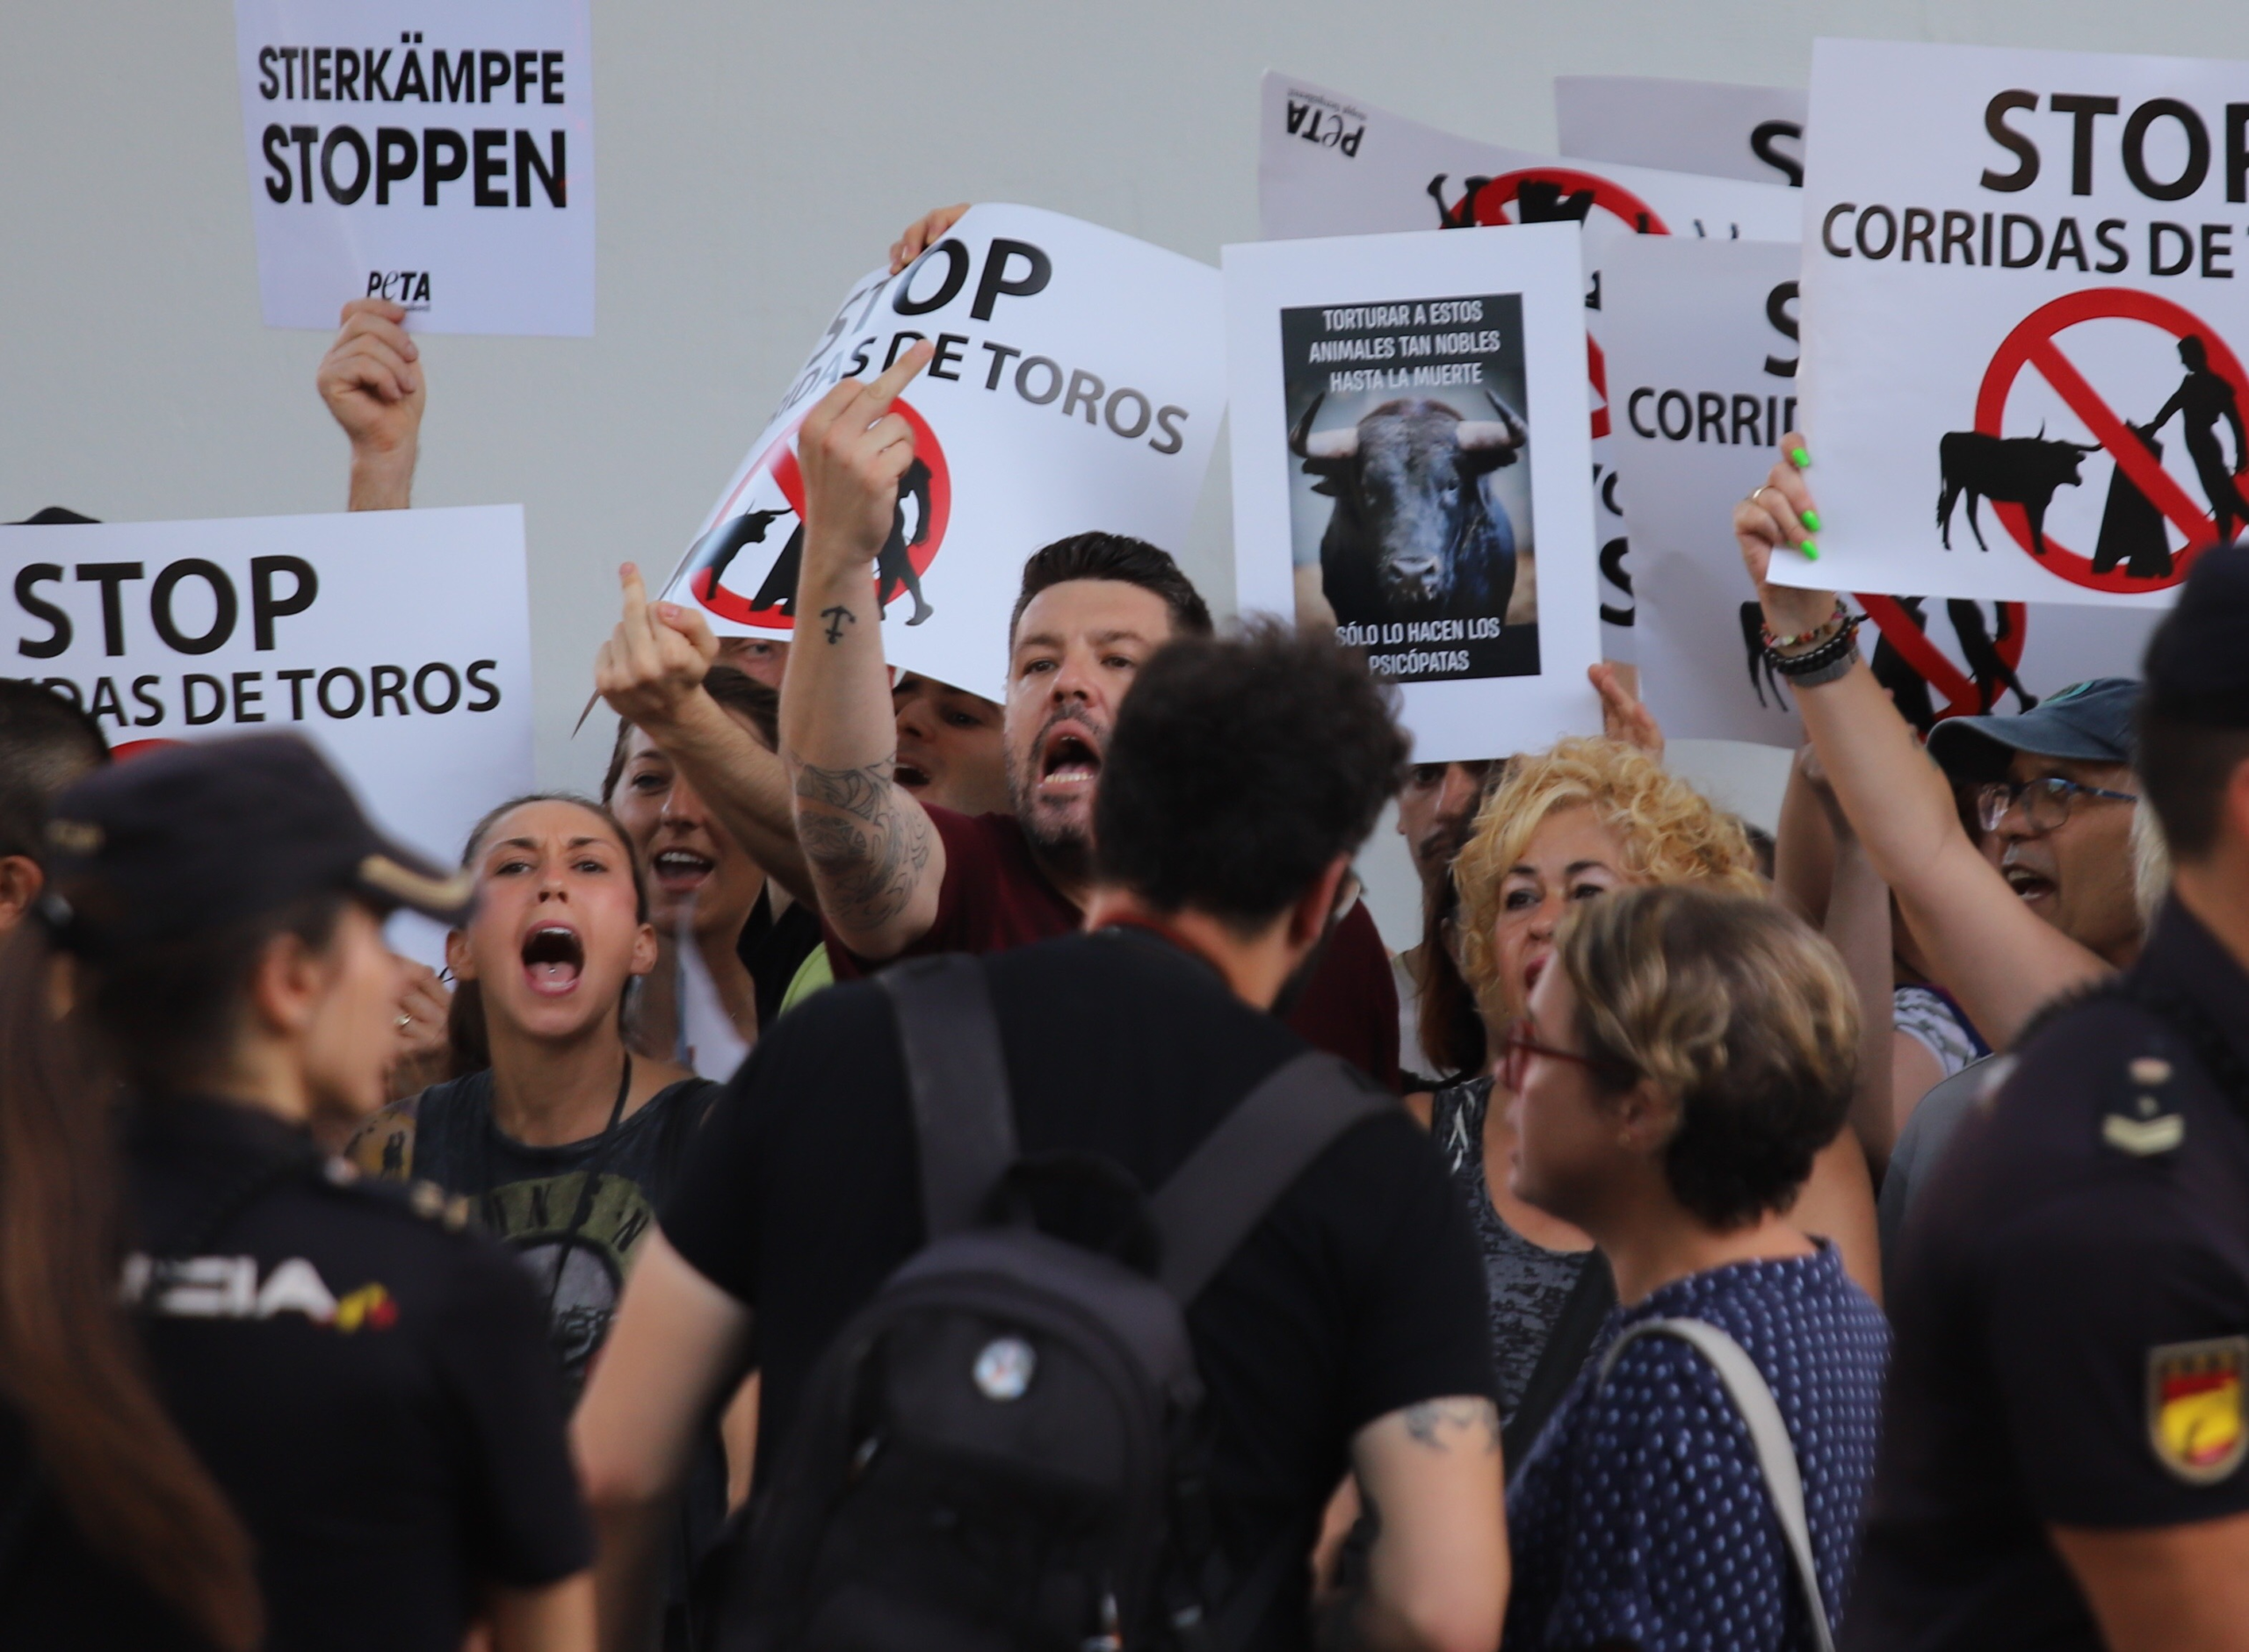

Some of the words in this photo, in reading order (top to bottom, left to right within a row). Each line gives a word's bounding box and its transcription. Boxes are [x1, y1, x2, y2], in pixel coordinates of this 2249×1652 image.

[259, 32, 564, 104] STIERKÄMPFE
[263, 123, 567, 208] STOPPEN
[1822, 202, 2129, 274] CORRIDAS
[2150, 221, 2234, 278] DE
[1309, 336, 1396, 364] ANIMALES
[1399, 335, 1432, 357] TAN
[1435, 330, 1501, 355] NOBLES
[1322, 305, 1410, 331] TORTURAR
[1414, 304, 1427, 326] A
[1429, 300, 1484, 325] ESTOS
[982, 341, 1190, 455] TOROS
[1330, 369, 1384, 393] HASTA
[1387, 367, 1408, 388] LA
[1414, 362, 1484, 386] MUERTE
[13, 554, 319, 660] STOP
[1335, 621, 1378, 646] SÓLO
[1382, 623, 1404, 645] LO
[1407, 619, 1464, 643] HACEN
[1468, 617, 1501, 639] LOS
[183, 670, 266, 725] DE
[278, 660, 502, 721] TOROS
[1369, 648, 1470, 675] PSICÓPATAS
